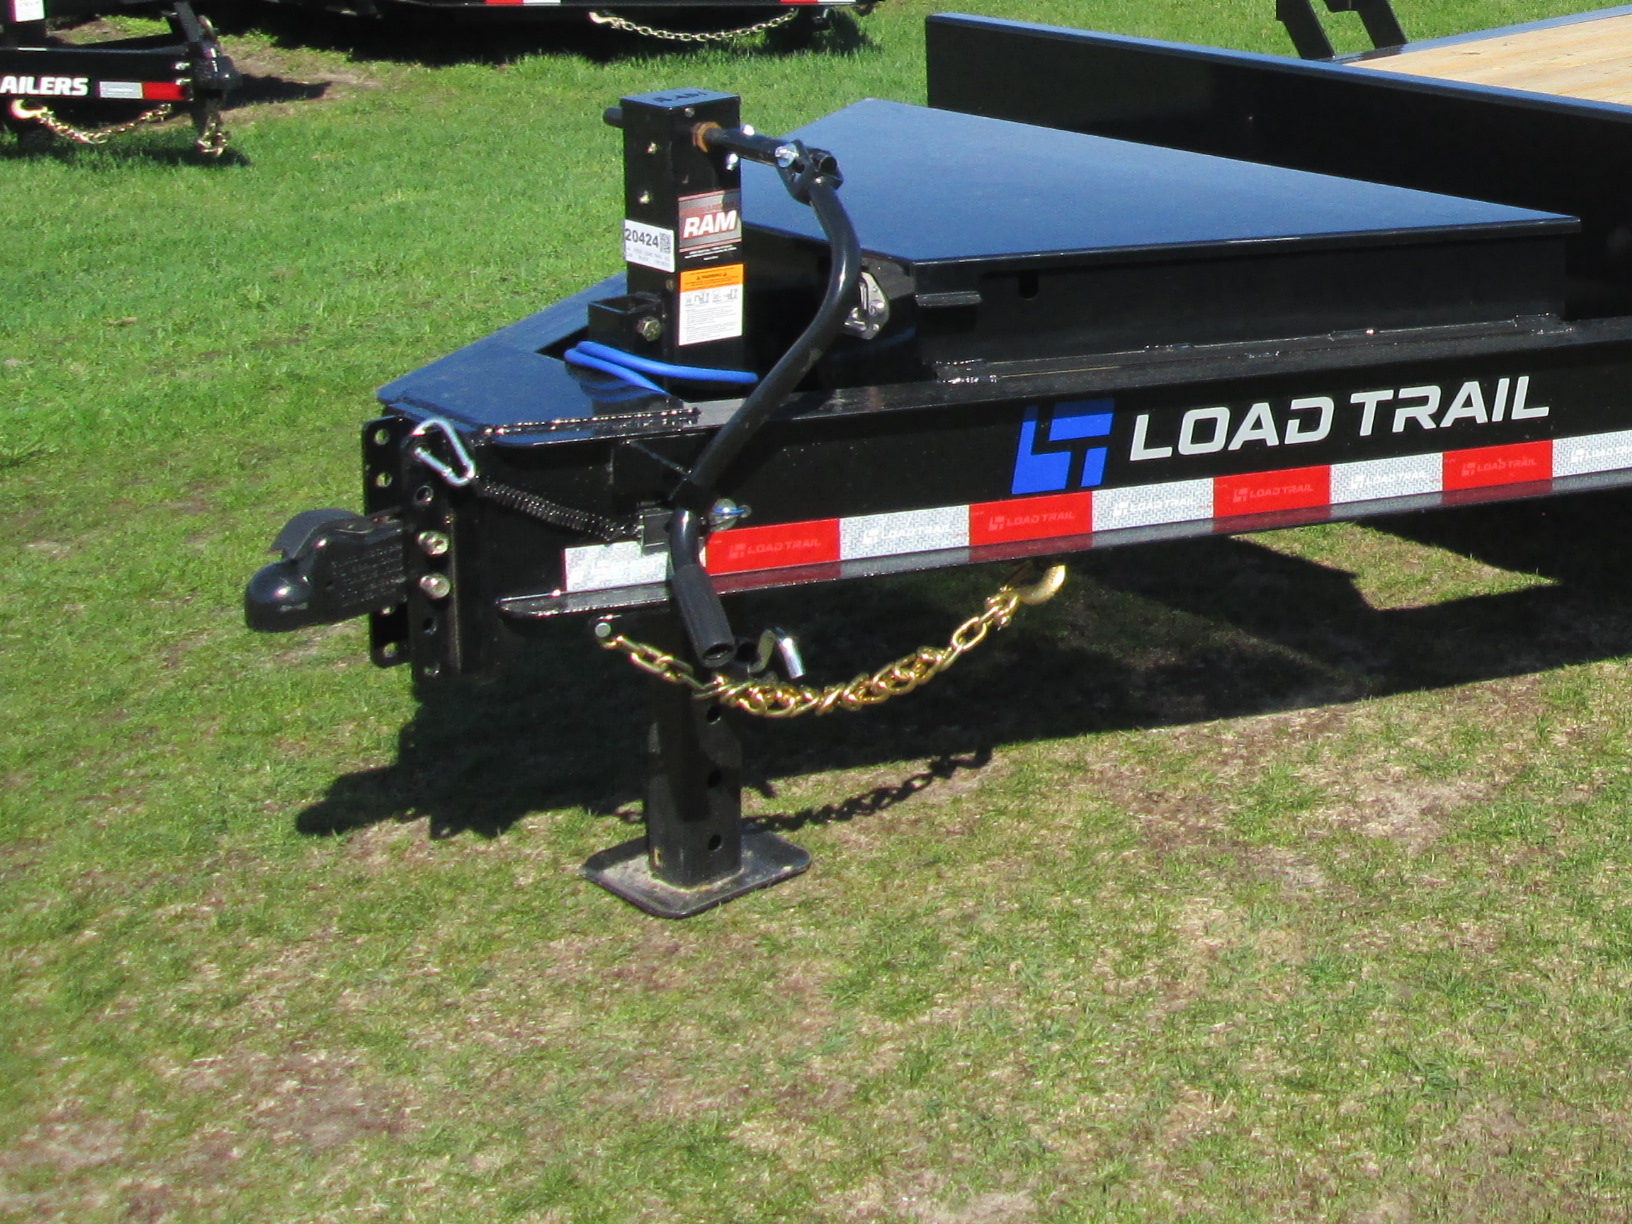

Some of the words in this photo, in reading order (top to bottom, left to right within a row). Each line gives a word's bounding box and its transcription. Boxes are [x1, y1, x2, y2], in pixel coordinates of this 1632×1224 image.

[683, 209, 738, 239] RAM
[624, 228, 659, 248] 20424
[1129, 396, 1336, 462] LOAD
[1350, 375, 1550, 437] TRAIL
[1477, 461, 1507, 473] LOAD
[1507, 457, 1538, 469] TRAIL
[1249, 486, 1281, 498] LOAD
[1281, 484, 1314, 495] TRAIL
[1006, 514, 1040, 527] LOAD
[1041, 510, 1076, 523] TRAIL
[747, 542, 782, 554] LOAD
[784, 538, 821, 551] TRAIL
